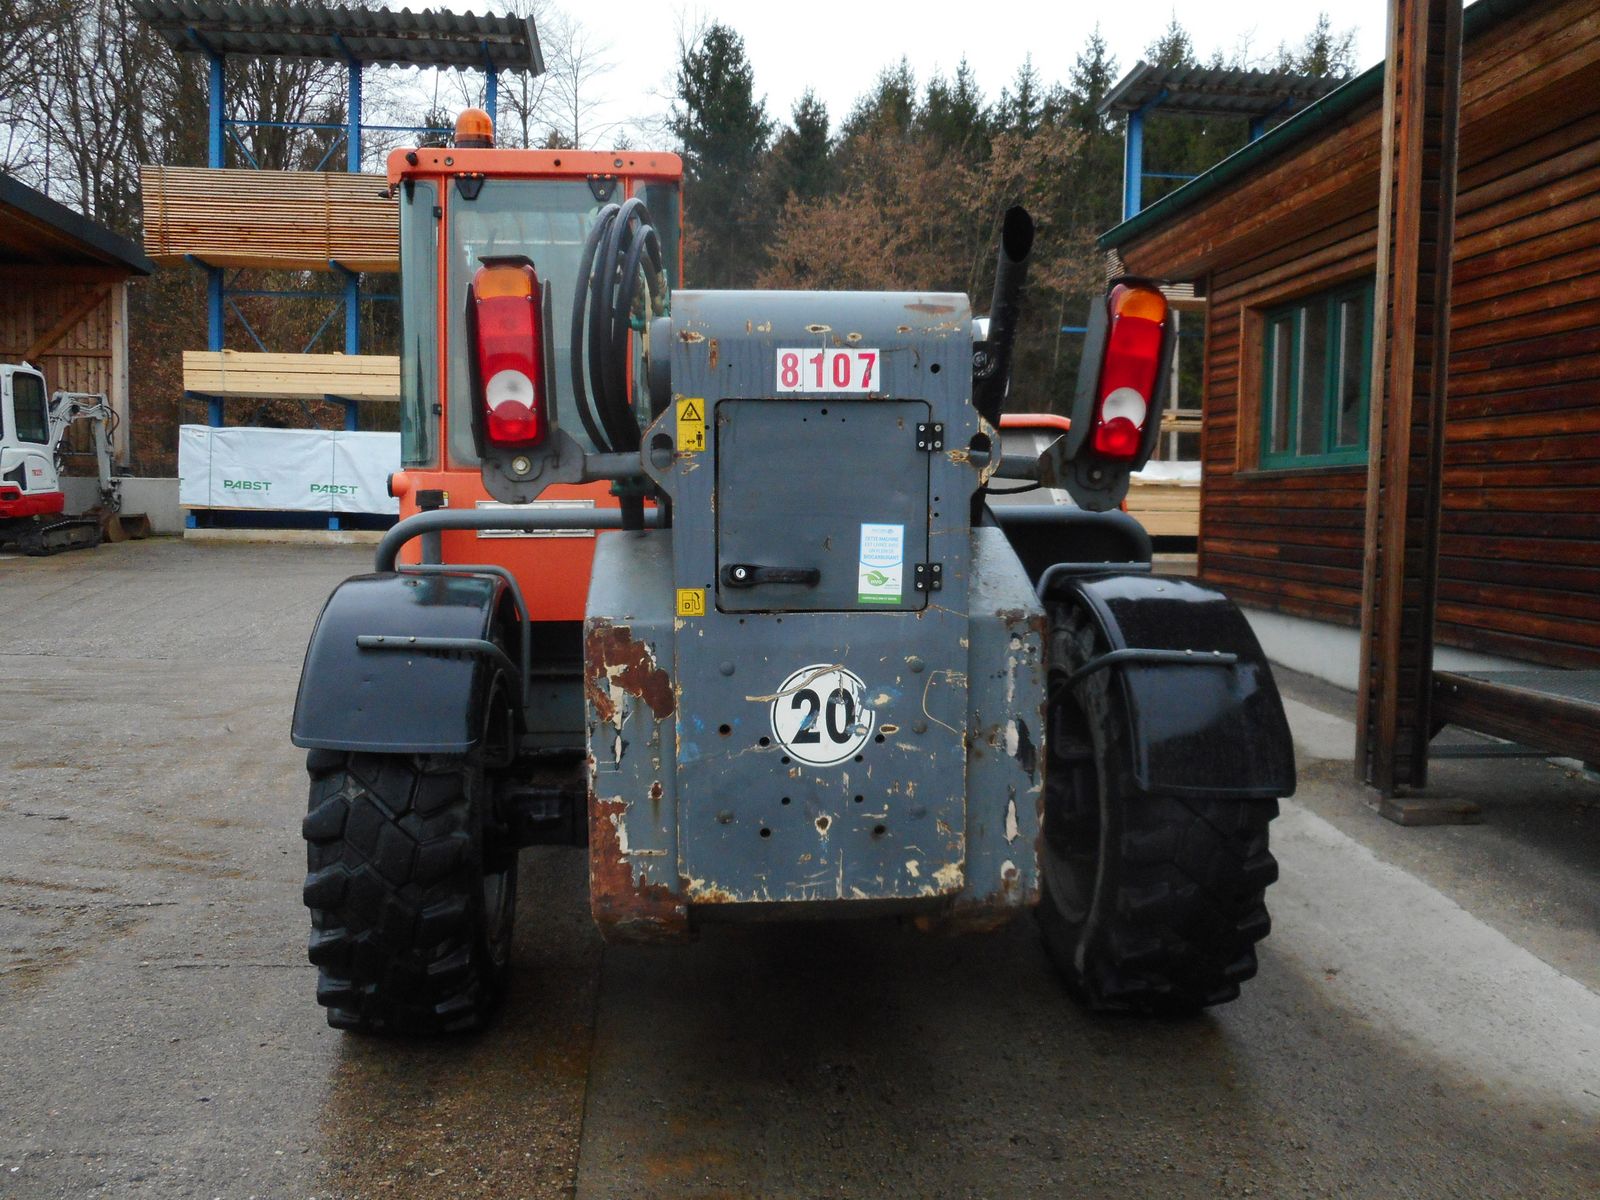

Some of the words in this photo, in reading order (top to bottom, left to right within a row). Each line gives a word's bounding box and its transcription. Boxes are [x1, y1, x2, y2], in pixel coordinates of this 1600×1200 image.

[781, 353, 876, 388] 8107
[223, 479, 272, 491] PABST
[310, 483, 358, 494] PABST
[791, 688, 855, 744] 20
